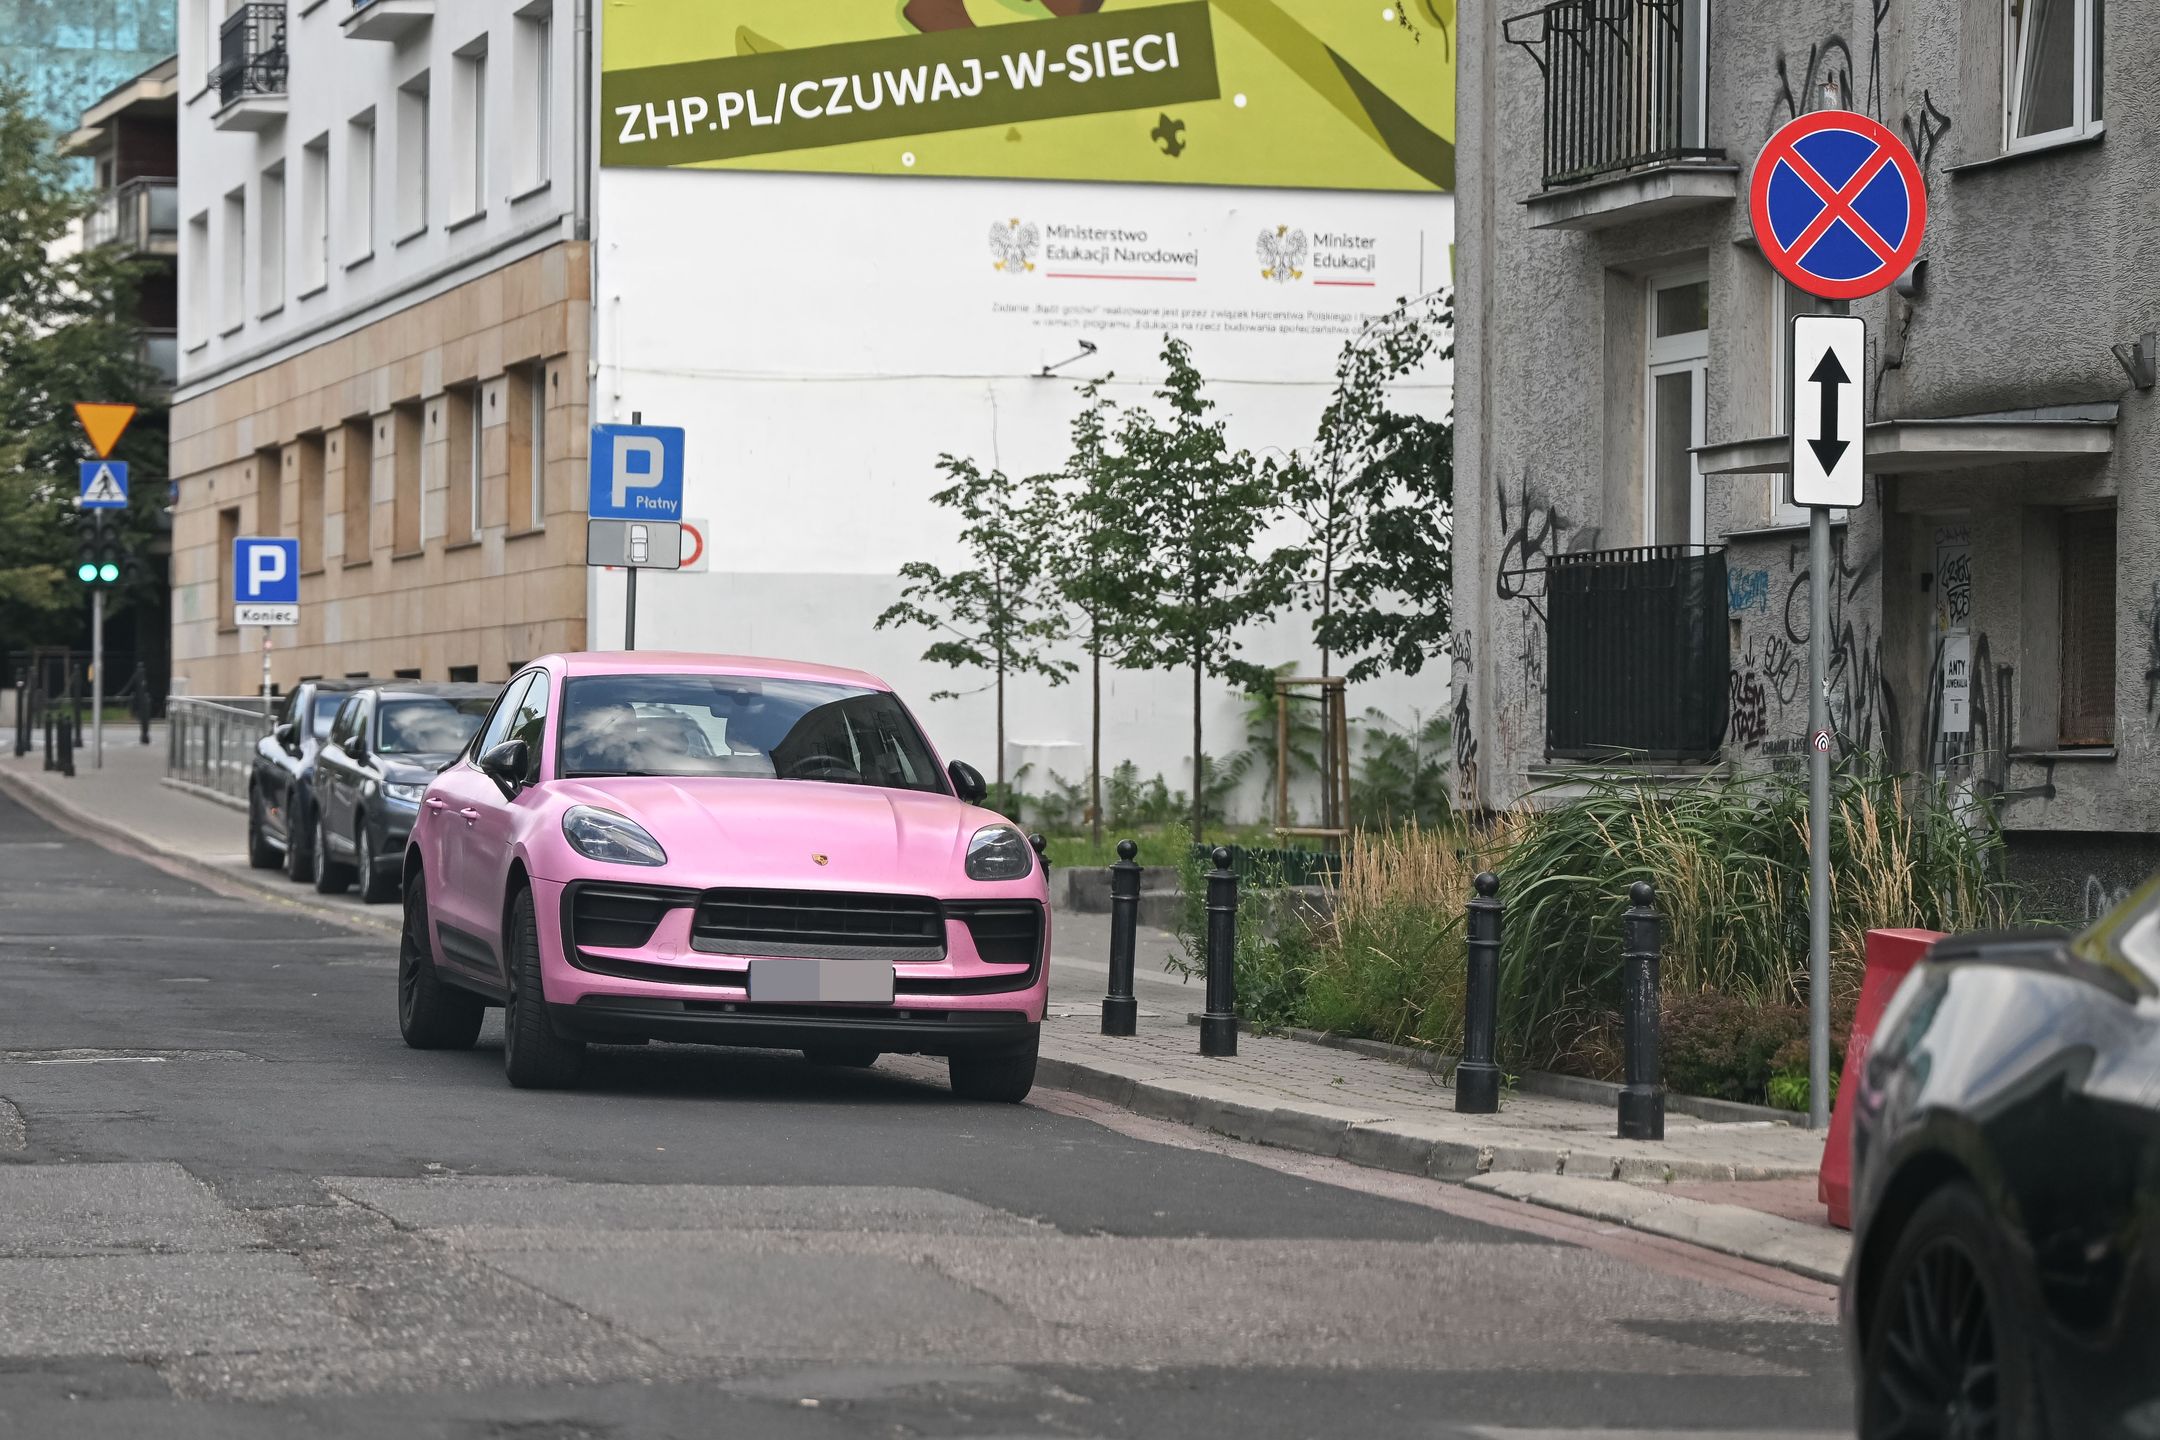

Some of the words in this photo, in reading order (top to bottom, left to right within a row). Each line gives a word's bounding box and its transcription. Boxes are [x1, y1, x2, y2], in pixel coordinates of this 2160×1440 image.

[615, 32, 1179, 144] ZHP.PL/CZUWAJ-W-SIECI
[1046, 224, 1148, 242] Ministerstwo
[1313, 233, 1376, 248] Minister
[1046, 244, 1110, 264] Edukacji
[1114, 247, 1199, 267] Narodowej
[1313, 252, 1376, 272] Edukacji
[612, 435, 665, 508] P
[636, 496, 678, 513] Płatny
[248, 544, 287, 597] P
[242, 608, 291, 622] Koniec
[1948, 659, 1966, 676] ANTY
